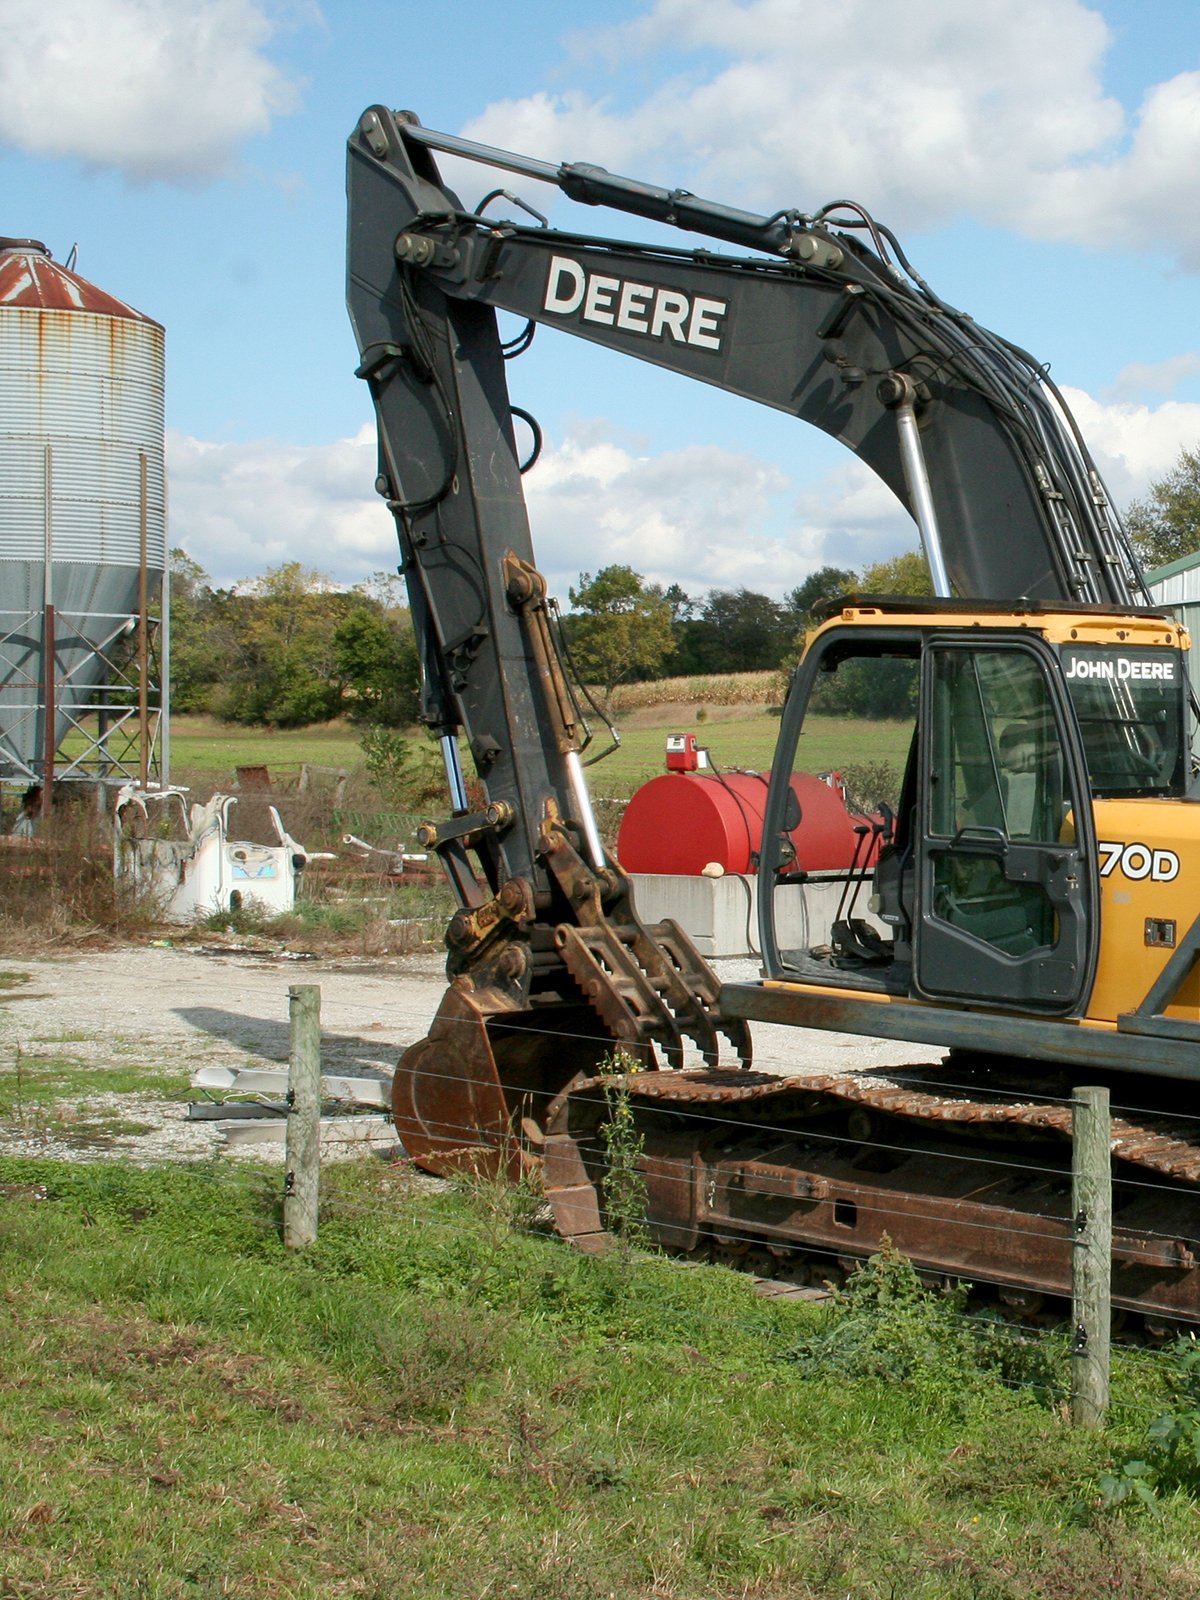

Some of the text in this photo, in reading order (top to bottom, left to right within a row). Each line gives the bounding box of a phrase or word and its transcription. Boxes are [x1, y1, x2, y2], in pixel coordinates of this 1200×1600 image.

[544, 255, 727, 350] DEERE
[1066, 657, 1174, 680] JOHN DEERE
